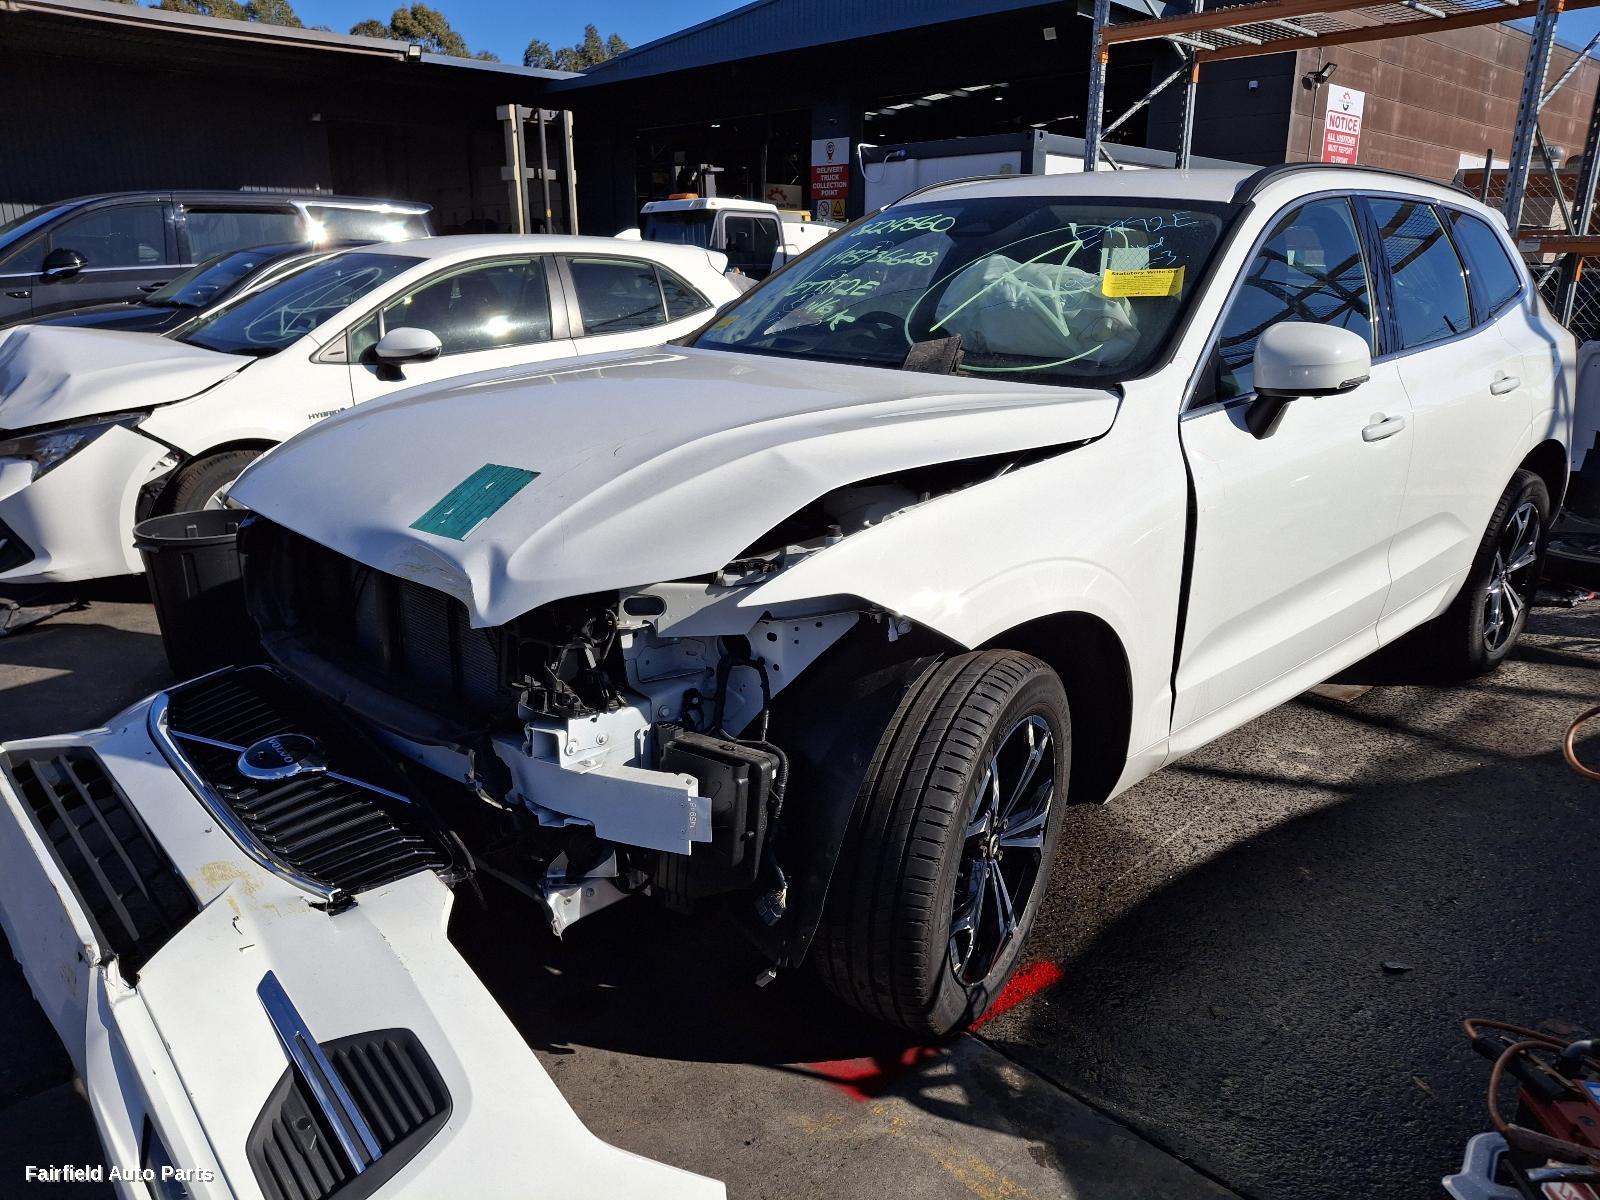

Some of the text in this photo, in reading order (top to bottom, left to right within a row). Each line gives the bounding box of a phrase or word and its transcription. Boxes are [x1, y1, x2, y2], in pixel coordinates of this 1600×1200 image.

[1329, 114, 1358, 132] NOTICE
[1327, 132, 1336, 142] ALL
[812, 181, 847, 189] COLLECTION
[267, 738, 294, 763] VOLVO
